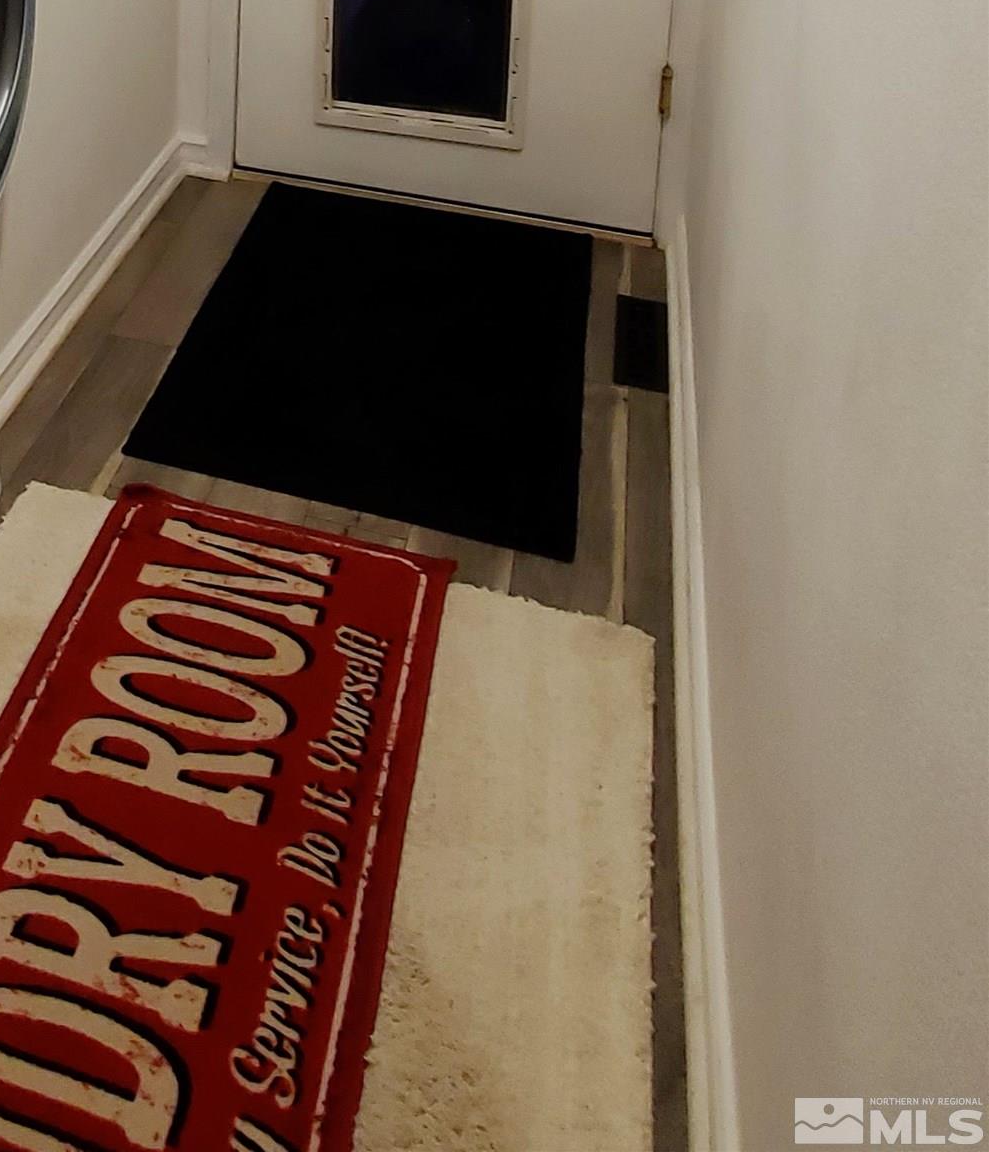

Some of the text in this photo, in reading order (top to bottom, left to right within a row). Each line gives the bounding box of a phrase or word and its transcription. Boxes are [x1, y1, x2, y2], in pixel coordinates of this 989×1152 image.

[50, 518, 332, 826] ROOM
[300, 783, 352, 826] It
[276, 832, 341, 888] Do
